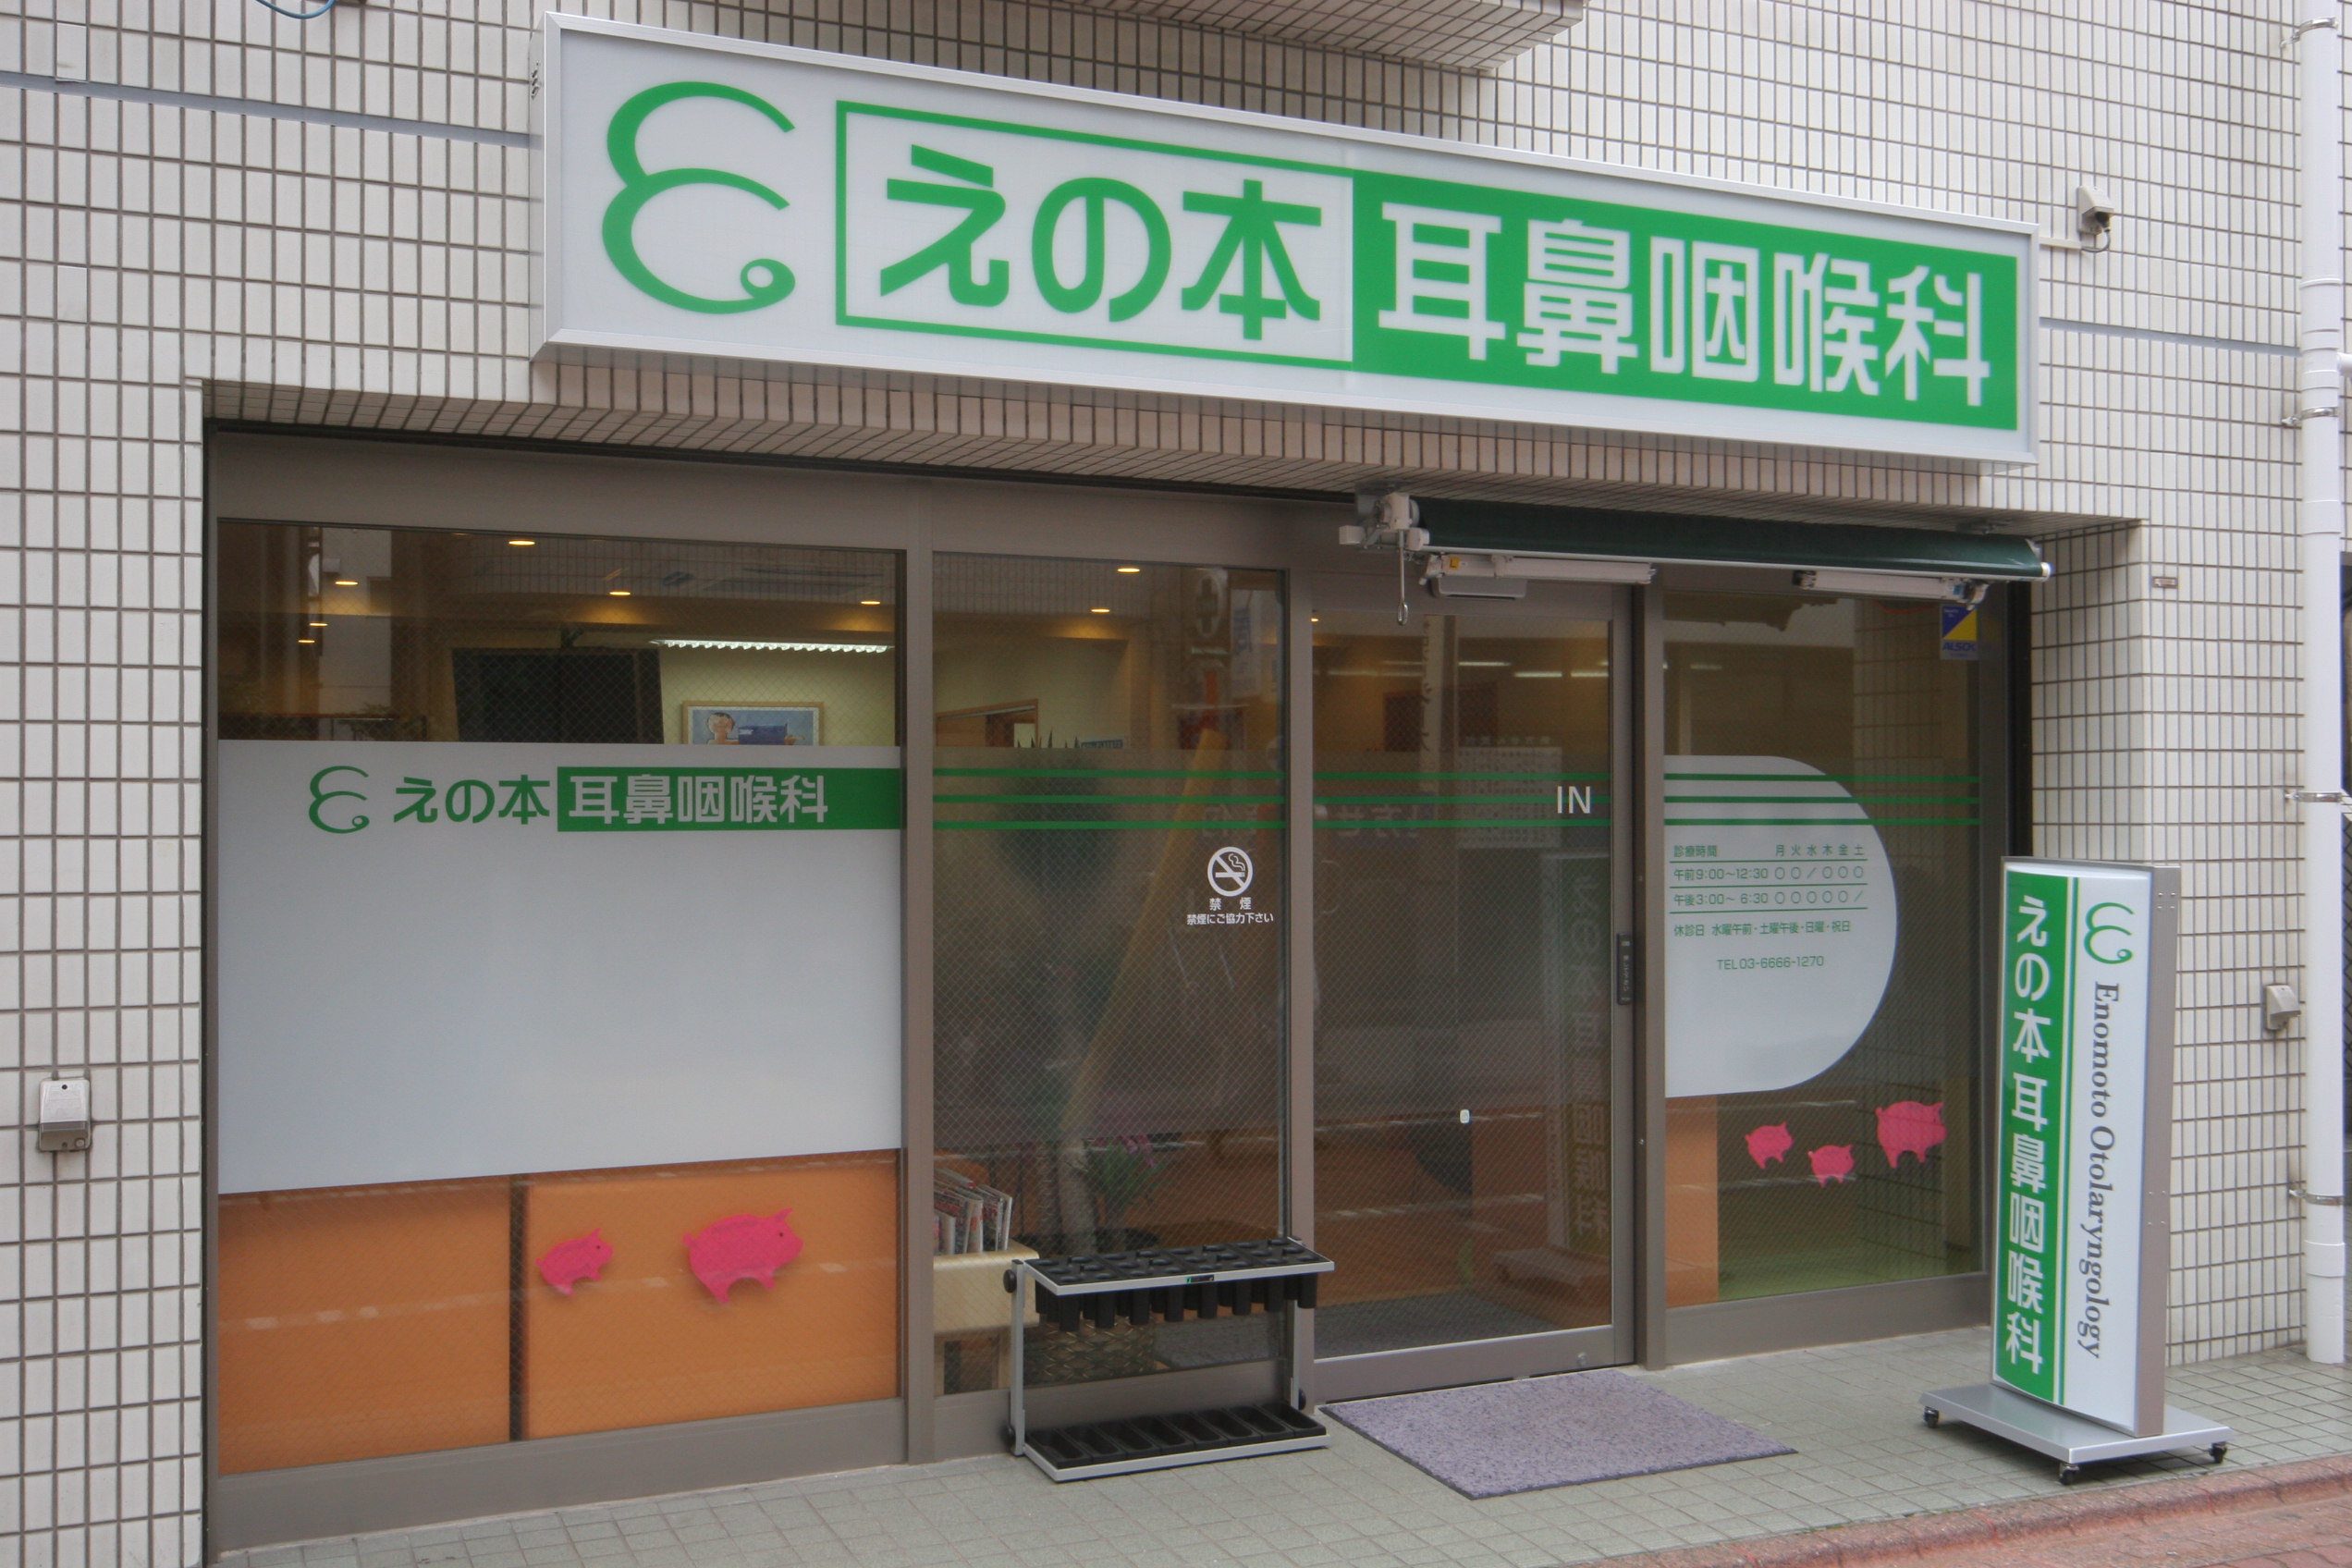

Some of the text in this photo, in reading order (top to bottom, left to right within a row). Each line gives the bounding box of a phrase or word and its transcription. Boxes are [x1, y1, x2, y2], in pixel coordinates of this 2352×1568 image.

[880, 144, 1990, 407] えの本 耳鼻咽喉科
[394, 774, 828, 825] えの本 耳鼻咽喉科
[1557, 786, 1592, 815] IN
[1186, 913, 1274, 925] 禁煙にご協力下さい
[2076, 981, 2120, 1359] Enomoto Otolaryngology
